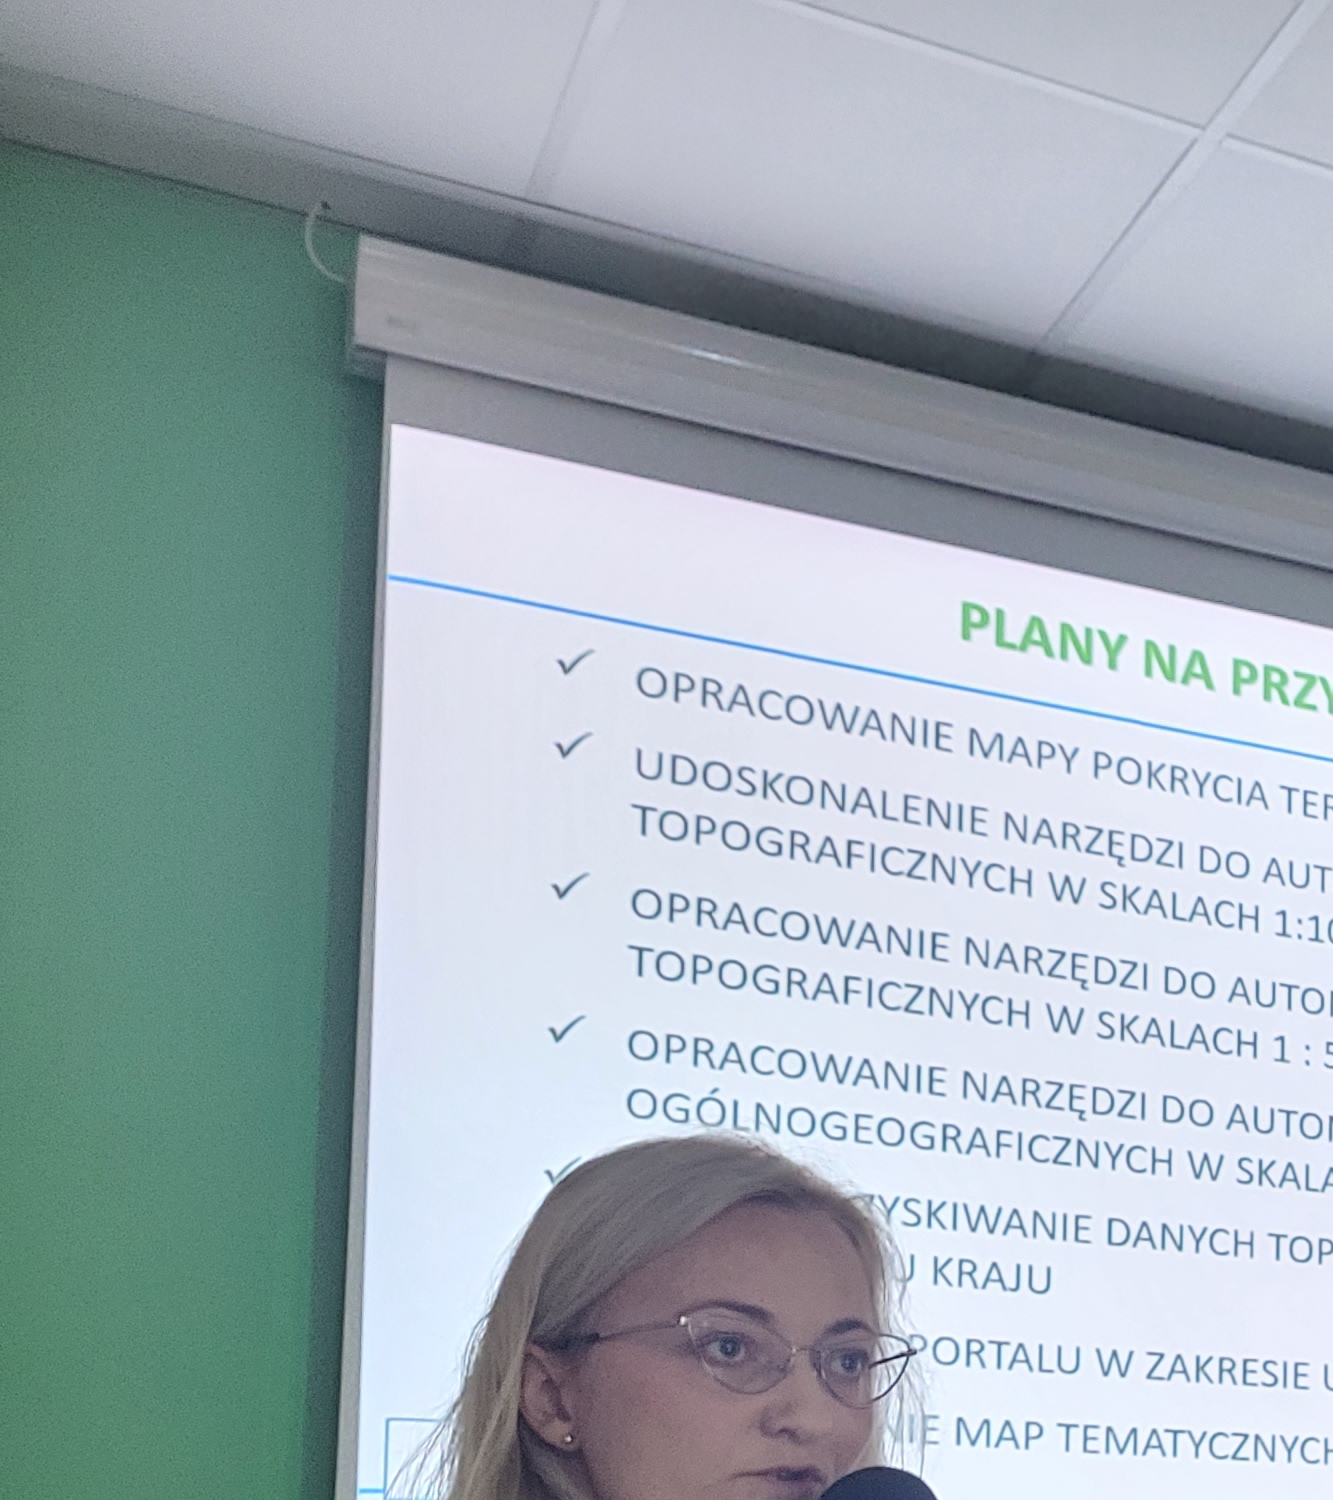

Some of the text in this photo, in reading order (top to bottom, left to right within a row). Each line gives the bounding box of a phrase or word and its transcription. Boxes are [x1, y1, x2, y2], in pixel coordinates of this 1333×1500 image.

[960, 600, 1129, 672] PLANY
[1143, 638, 1216, 692] NA
[635, 666, 954, 754] OPRACOWANIE
[968, 727, 1081, 775] MAPY
[1092, 750, 1270, 811] POKRYCIA
[635, 747, 989, 838] UDOSKONALENIE
[1003, 811, 1184, 870] NARZĘDZI
[1199, 844, 1251, 880] DO
[630, 803, 1033, 899] TOPOGRAFICZNYCH
[1047, 871, 1088, 906] W
[1098, 880, 1260, 934] SKALACH
[630, 887, 950, 964] OPRACOWANIE
[964, 935, 1149, 992] NARZĘDZI
[1163, 965, 1217, 1000] DO
[626, 944, 1031, 1031] TOPOGRAFICZNYCH
[1045, 1002, 1086, 1036] W
[1096, 1010, 1259, 1060] SKALACH
[1272, 1034, 1292, 1064] 1
[627, 1029, 948, 1098] OPRACOWANIE
[962, 1070, 1147, 1123] NARZĘDZI
[1161, 1094, 1215, 1128] DO
[626, 1087, 1174, 1178] OGÓLNOGEOGRAFICZNYCH
[1187, 1149, 1225, 1182] W
[932, 1255, 1053, 1296] KRAJU
[1106, 1217, 1255, 1260] DANYCH
[1095, 1347, 1135, 1379] W
[1145, 1351, 1311, 1391] ZAKRESIE
[955, 1416, 1045, 1451] MAP
